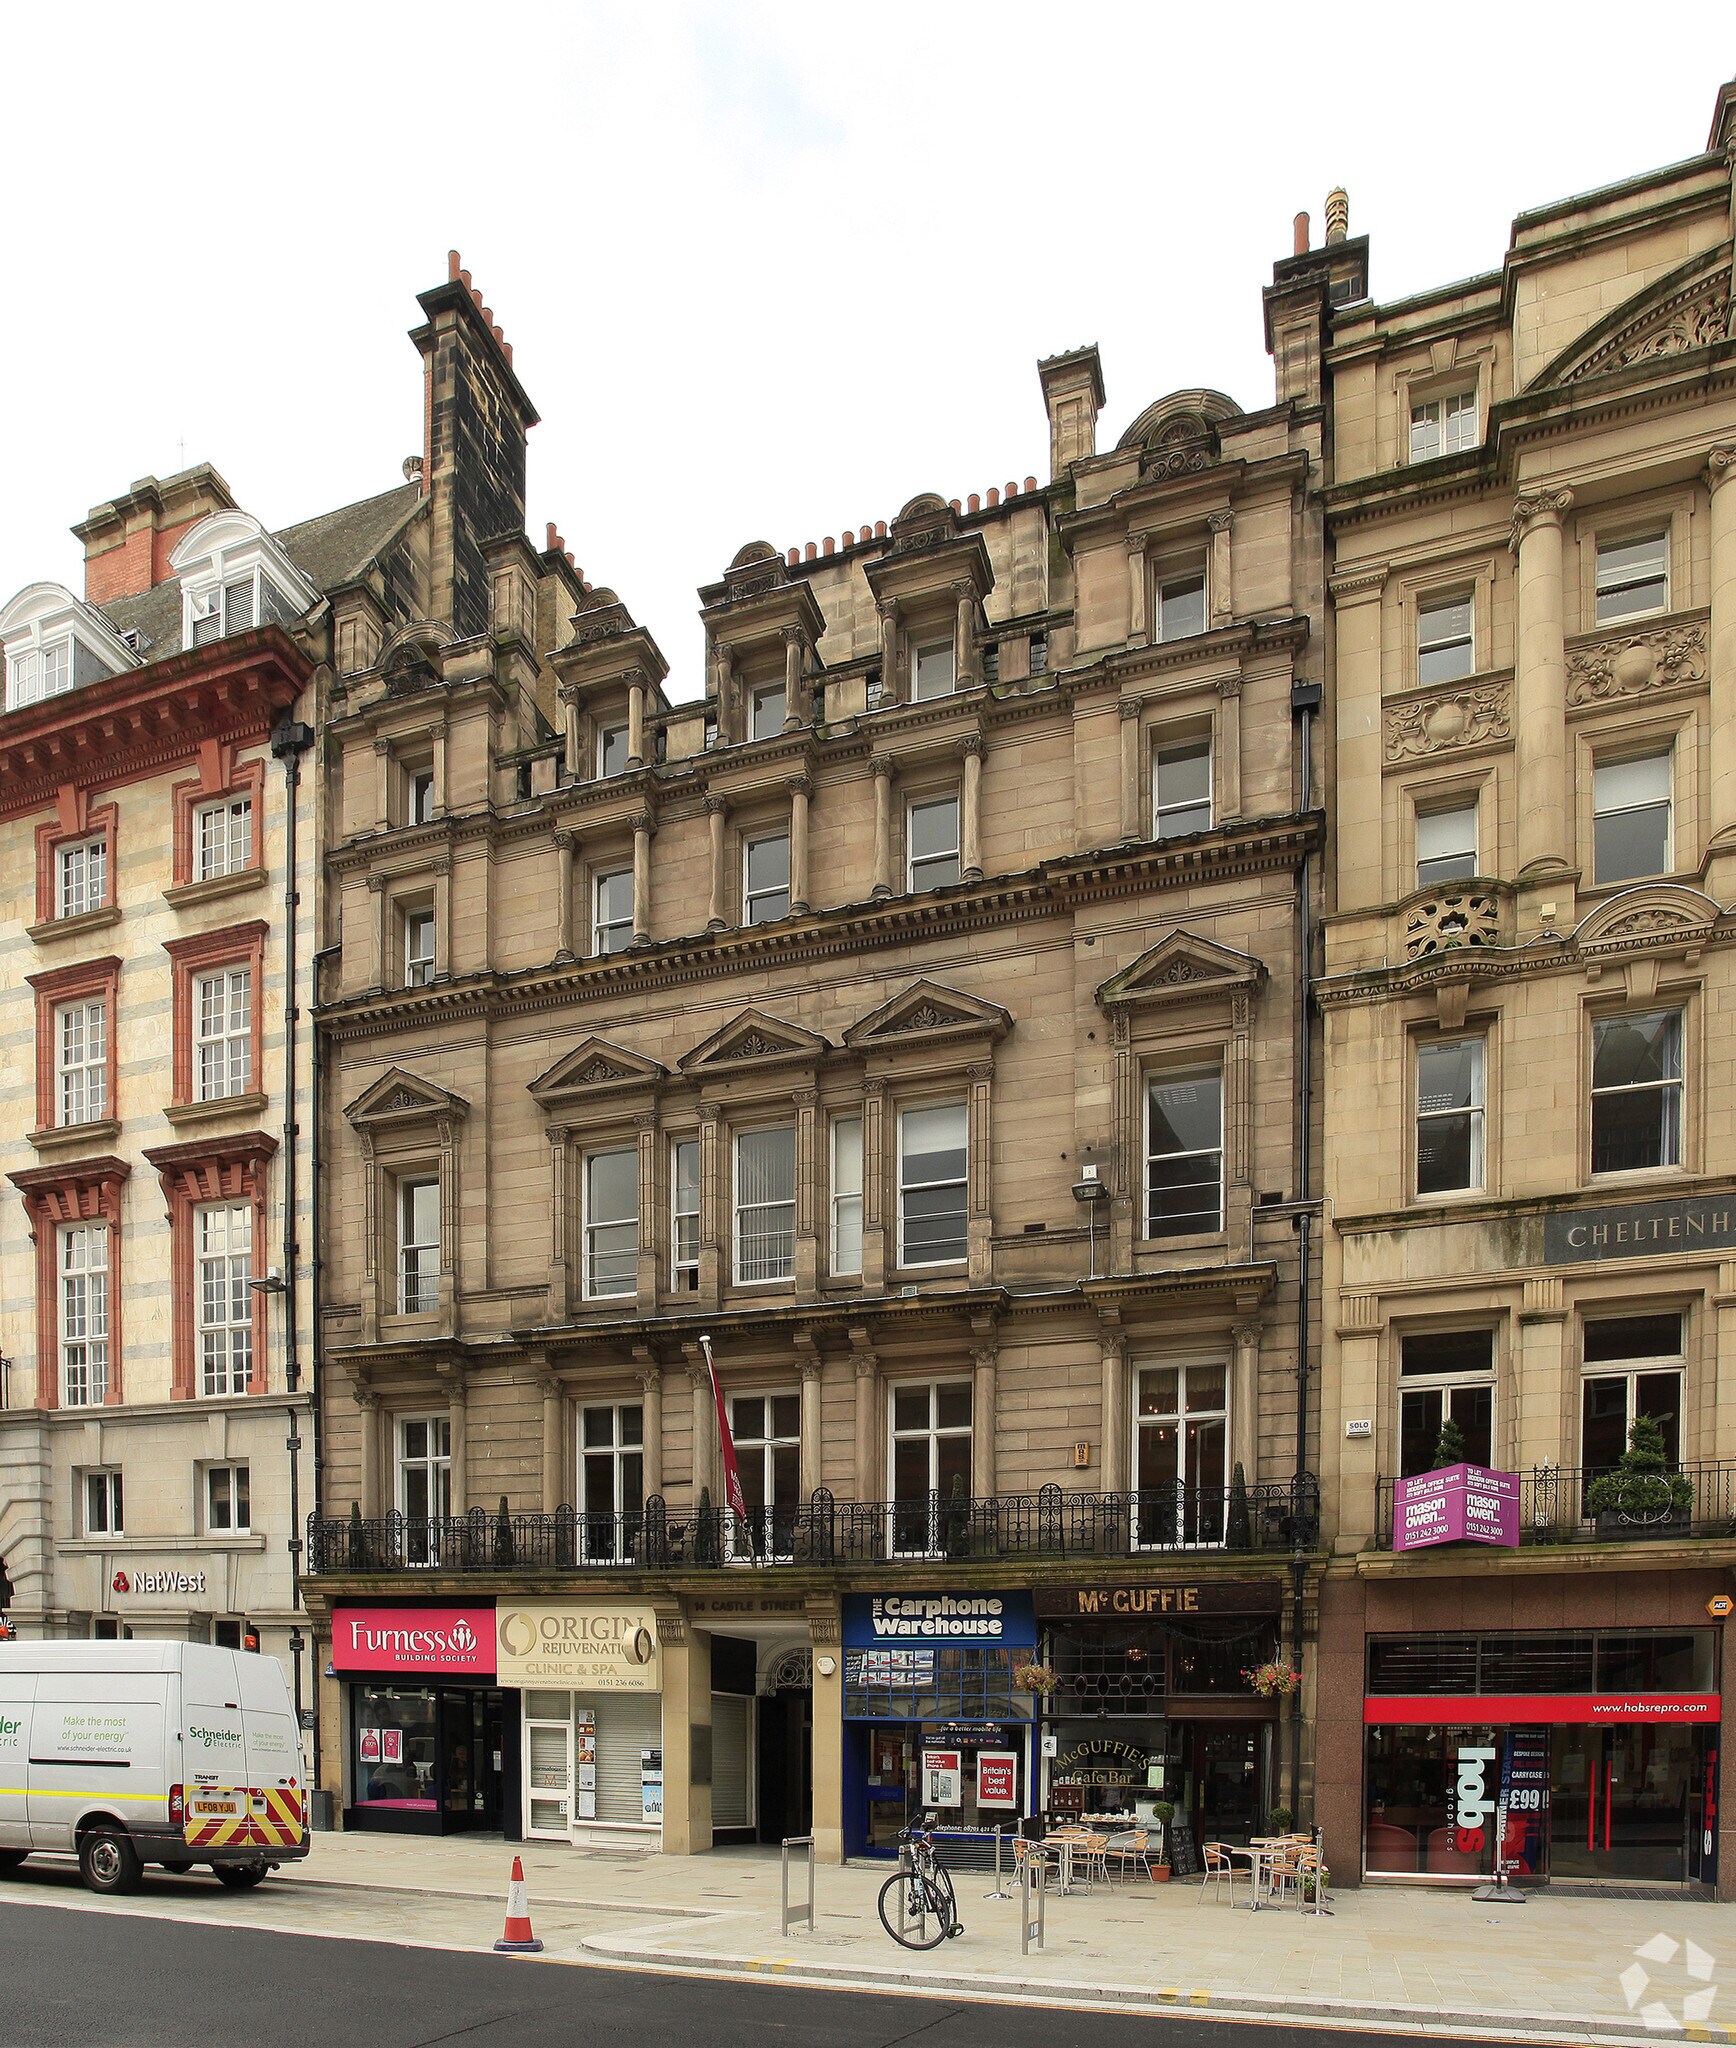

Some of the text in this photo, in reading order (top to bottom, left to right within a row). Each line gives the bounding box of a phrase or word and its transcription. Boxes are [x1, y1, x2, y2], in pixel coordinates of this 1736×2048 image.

[1567, 1211, 1736, 1248] CHELTENH
[1350, 1421, 1369, 1429] SOLO
[1467, 1467, 1473, 1475] TO
[1427, 1478, 1445, 1487] OFFICE
[1445, 1474, 1460, 1482] SUITE
[1485, 1477, 1499, 1486] OFFICE
[1405, 1497, 1446, 1517] mason
[1466, 1493, 1500, 1511] mason
[1405, 1525, 1449, 1540] 0151 242 3000
[1466, 1522, 1503, 1536] 0151 242 3000
[133, 1571, 206, 1592] NatWest
[711, 1601, 754, 1611] CASTLE
[760, 1600, 804, 1611] STREET
[872, 1598, 883, 1618] THE
[884, 1595, 1003, 1619] Carphone
[872, 1617, 1003, 1635] Warehouse
[350, 1621, 446, 1652] Furness
[542, 1642, 624, 1656] REJUVENATI
[395, 1654, 477, 1662] BUILDING SOCIETY
[526, 1663, 618, 1675] CLINIC & SPA
[598, 1678, 613, 1686] 0151
[615, 1679, 628, 1687] 236
[628, 1679, 645, 1687] 6086
[1593, 1702, 1708, 1714] www.hobsrepro.com
[63, 1716, 127, 1727] Make the most
[62, 1730, 126, 1743] of your energy
[189, 1726, 242, 1741] Schneider
[57, 1745, 132, 1753] www.schneider-electric.co.uk
[213, 1740, 242, 1749] Electric
[1055, 1739, 1152, 1771] McGUFFIE'S
[982, 1766, 1012, 1775] Britain's
[1072, 1770, 1106, 1784] Cafe
[1108, 1771, 1134, 1784] Bar
[988, 1777, 1006, 1785] best
[984, 1787, 1009, 1795] value.
[1457, 1747, 1496, 1854] hobs
[1509, 1789, 1540, 1811] £99
[198, 1802, 234, 1813] LF08 YJU
[934, 1824, 962, 1832] elephone:
